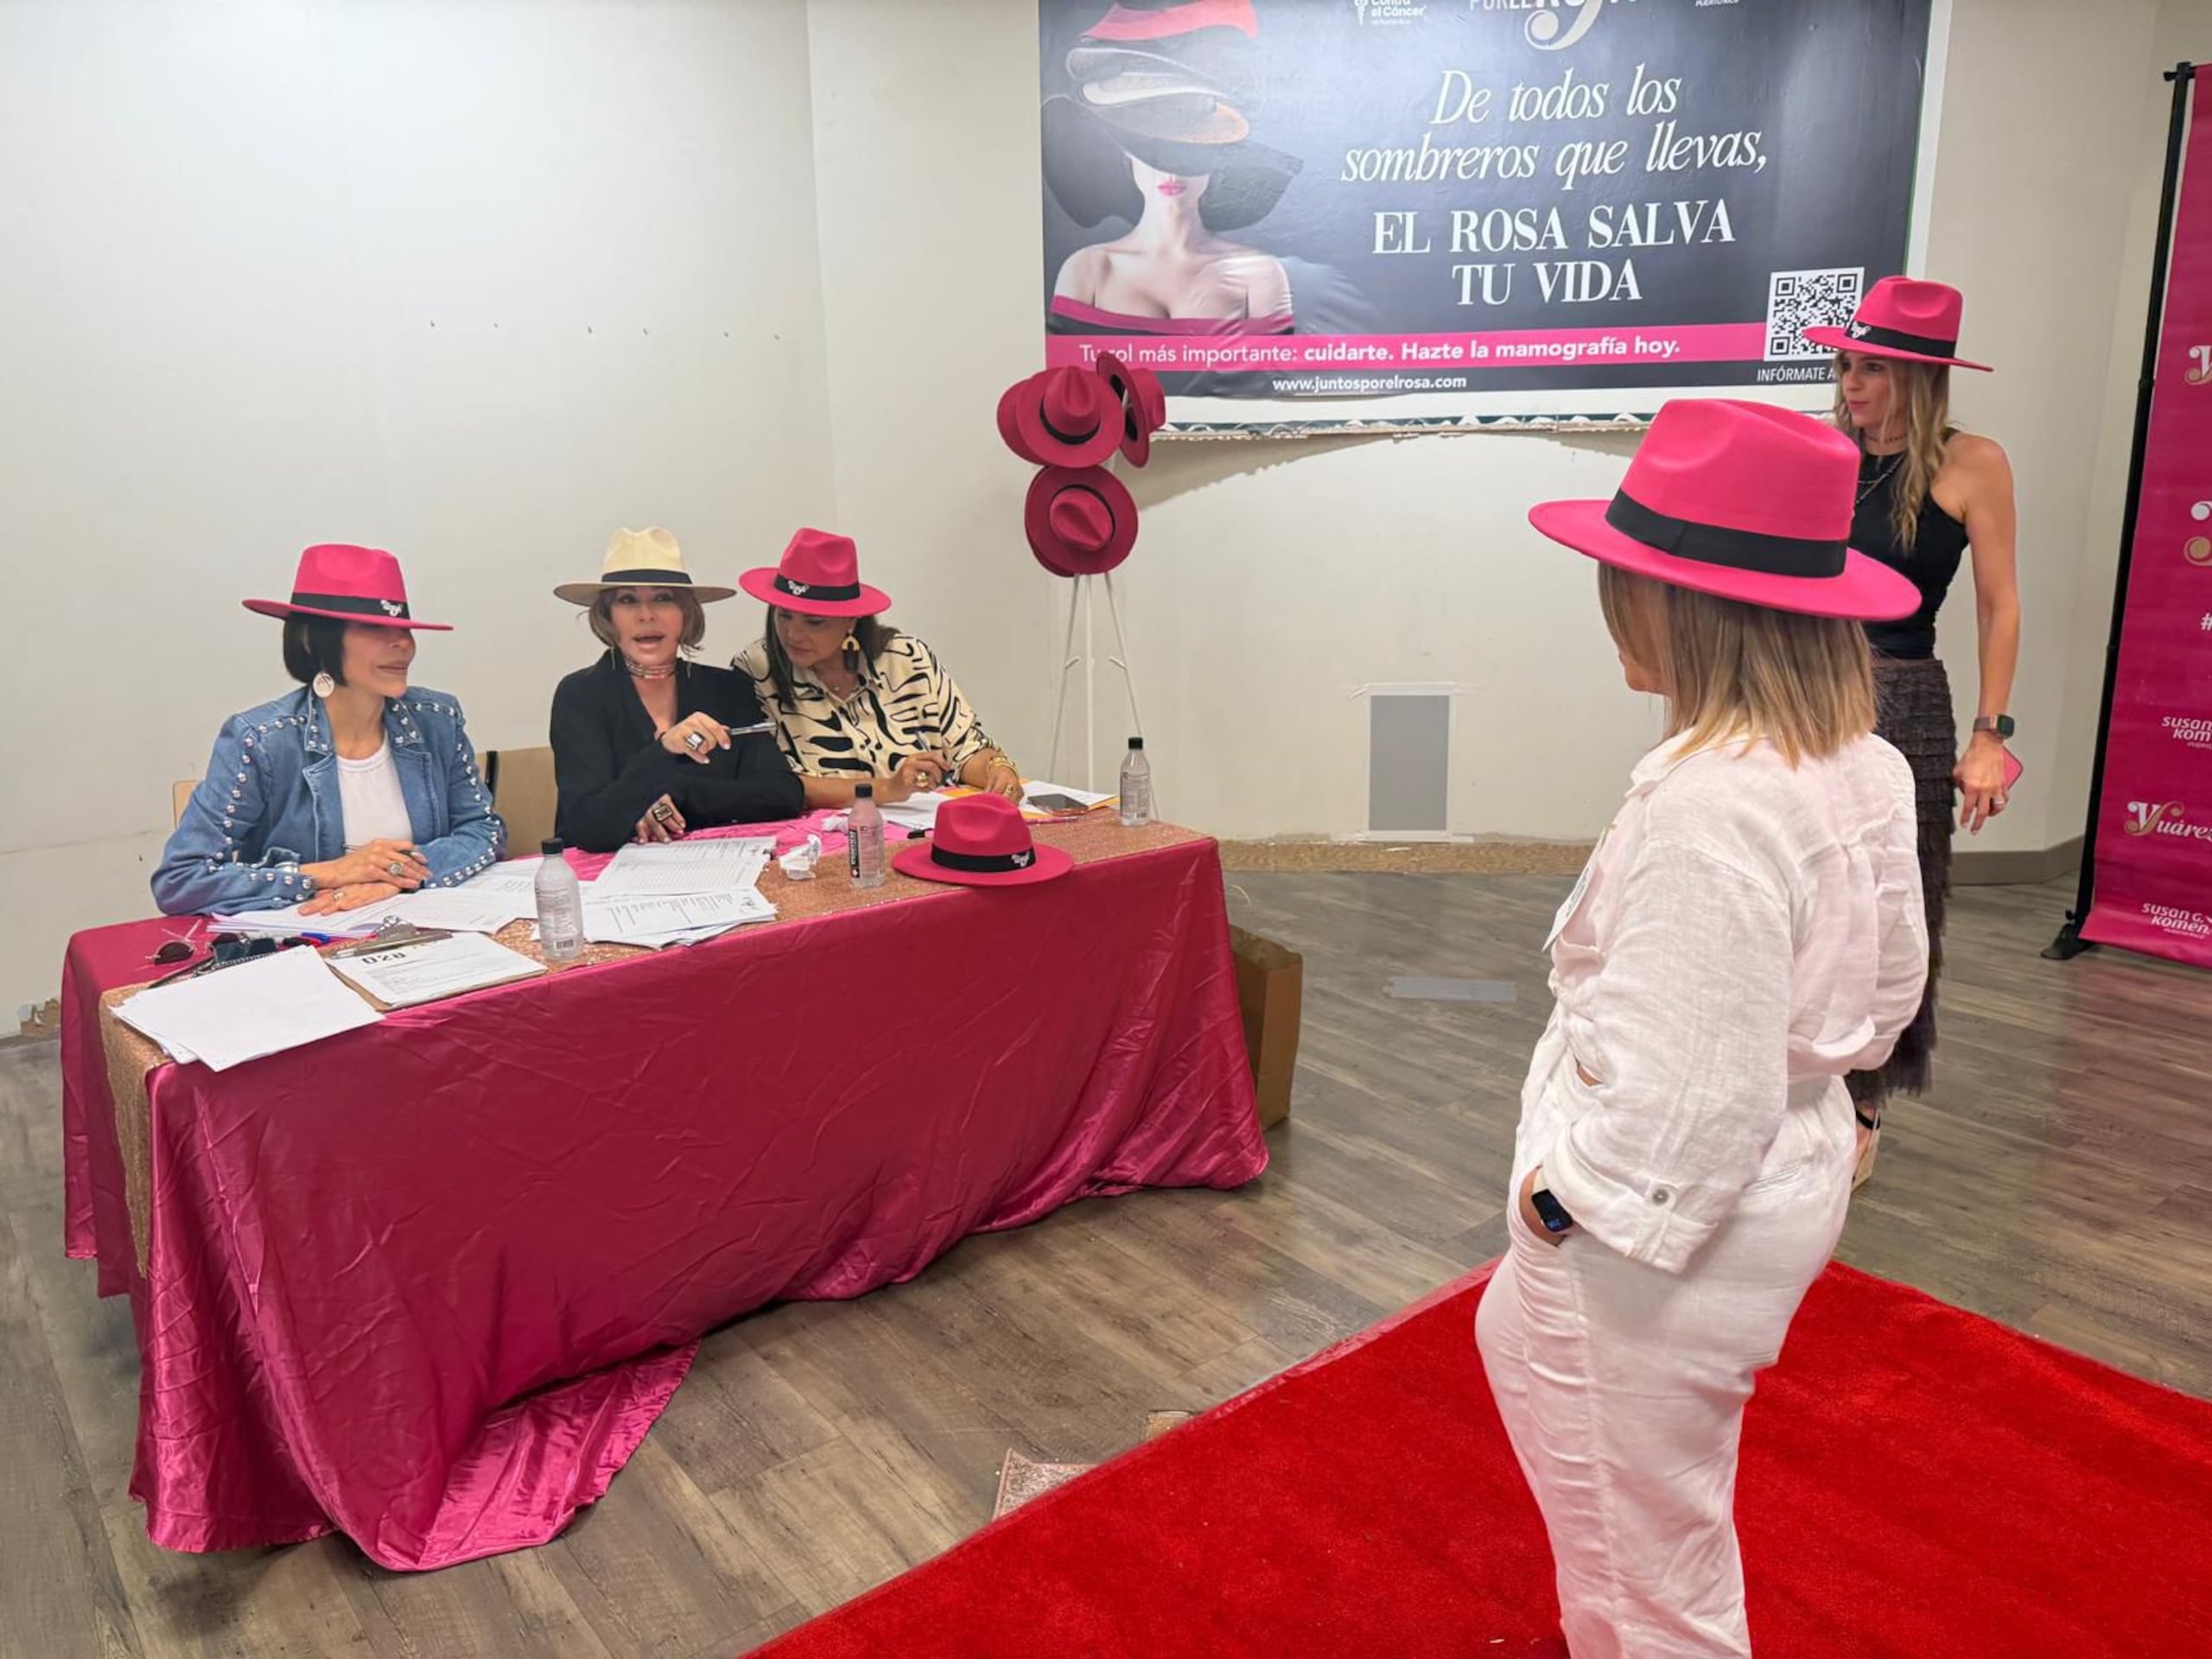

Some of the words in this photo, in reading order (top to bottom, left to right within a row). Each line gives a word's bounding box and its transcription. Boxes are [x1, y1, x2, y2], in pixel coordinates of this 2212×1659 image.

[1370, 7, 1382, 16] el
[1428, 69, 1491, 124] De
[1509, 67, 1610, 123] todos
[1625, 63, 1682, 116] los
[1341, 131, 1540, 182] sombreros
[1554, 138, 1629, 190] que
[1645, 120, 1768, 174] llevas,
[1371, 211, 1431, 255] EL
[1449, 207, 1569, 253] ROSA
[1587, 198, 1736, 249] SALVA
[1452, 264, 1516, 307] TU
[1533, 258, 1643, 304] VIDA
[1108, 343, 1133, 362] ol
[1139, 344, 1177, 362] más
[1182, 343, 1298, 367] importante:
[1304, 341, 1394, 361] cuidarte.
[1401, 342, 1464, 360] Hazte
[1471, 340, 1490, 359] la
[1496, 336, 1627, 362] mamografía
[1635, 335, 1681, 358] hoy.
[1272, 375, 1467, 393] www.juntosporelrosa.com
[1757, 365, 1825, 382] INFÓRMATE
[2142, 903, 2190, 920] susan
